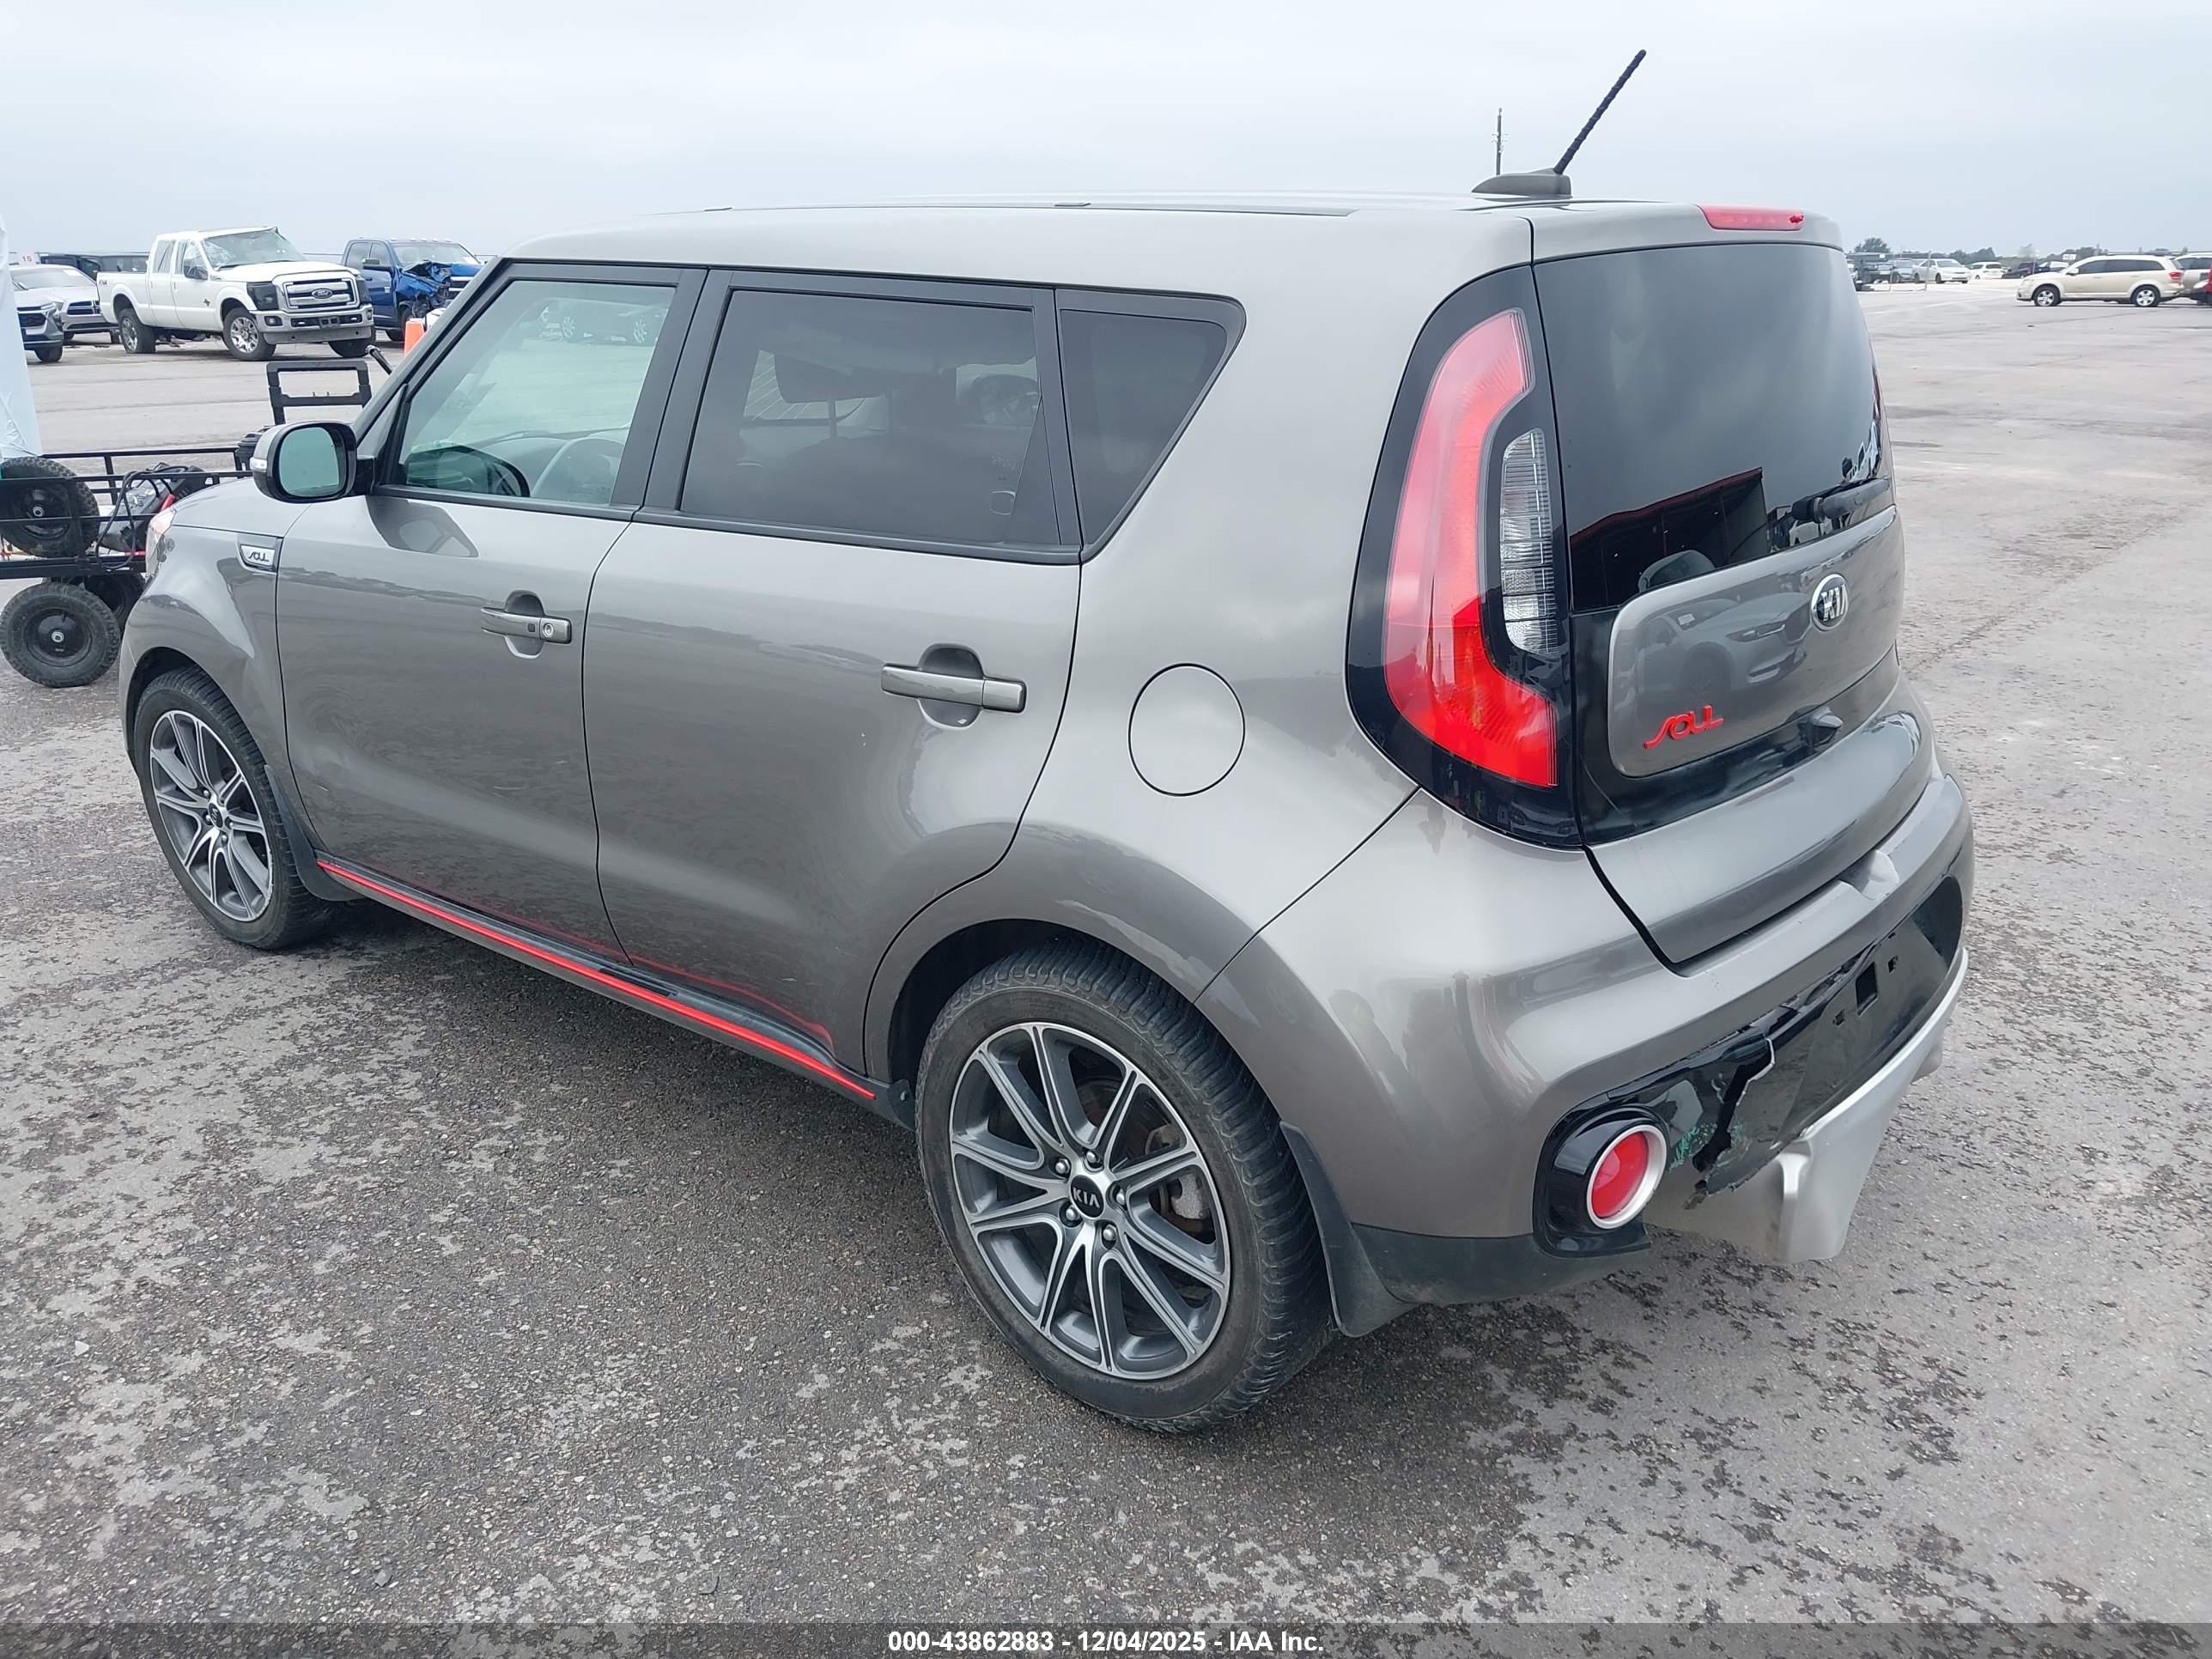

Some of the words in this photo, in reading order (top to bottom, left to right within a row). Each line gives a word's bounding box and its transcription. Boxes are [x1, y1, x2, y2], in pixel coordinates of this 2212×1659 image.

[248, 551, 270, 562] SOUL
[1820, 584, 1847, 622] KIA
[1643, 703, 1724, 750] SOUL
[1073, 1186, 1101, 1209] KIA
